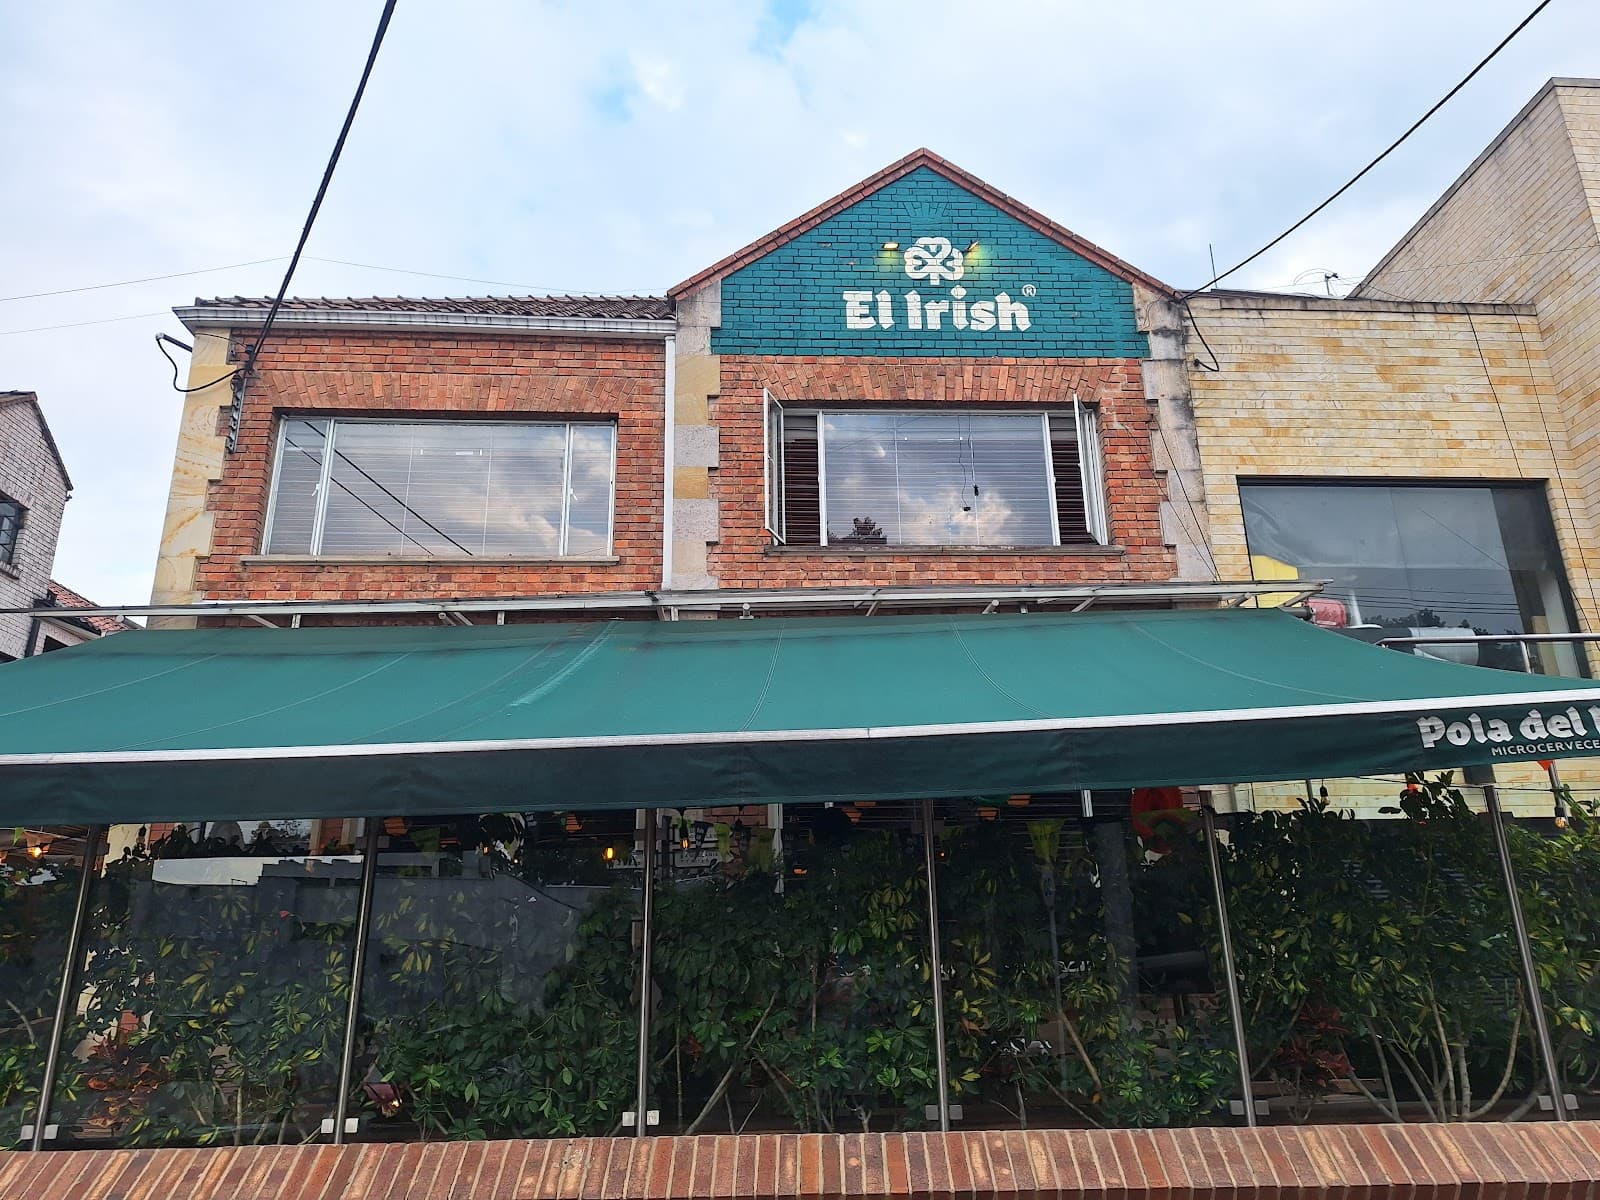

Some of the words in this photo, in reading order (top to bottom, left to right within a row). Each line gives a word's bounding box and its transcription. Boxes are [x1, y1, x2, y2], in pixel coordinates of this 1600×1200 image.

[843, 289, 895, 330] El
[904, 284, 1032, 332] Irish
[1415, 712, 1514, 749] Pola
[1519, 706, 1588, 741] del
[1491, 739, 1600, 757] MICROCERVECE
